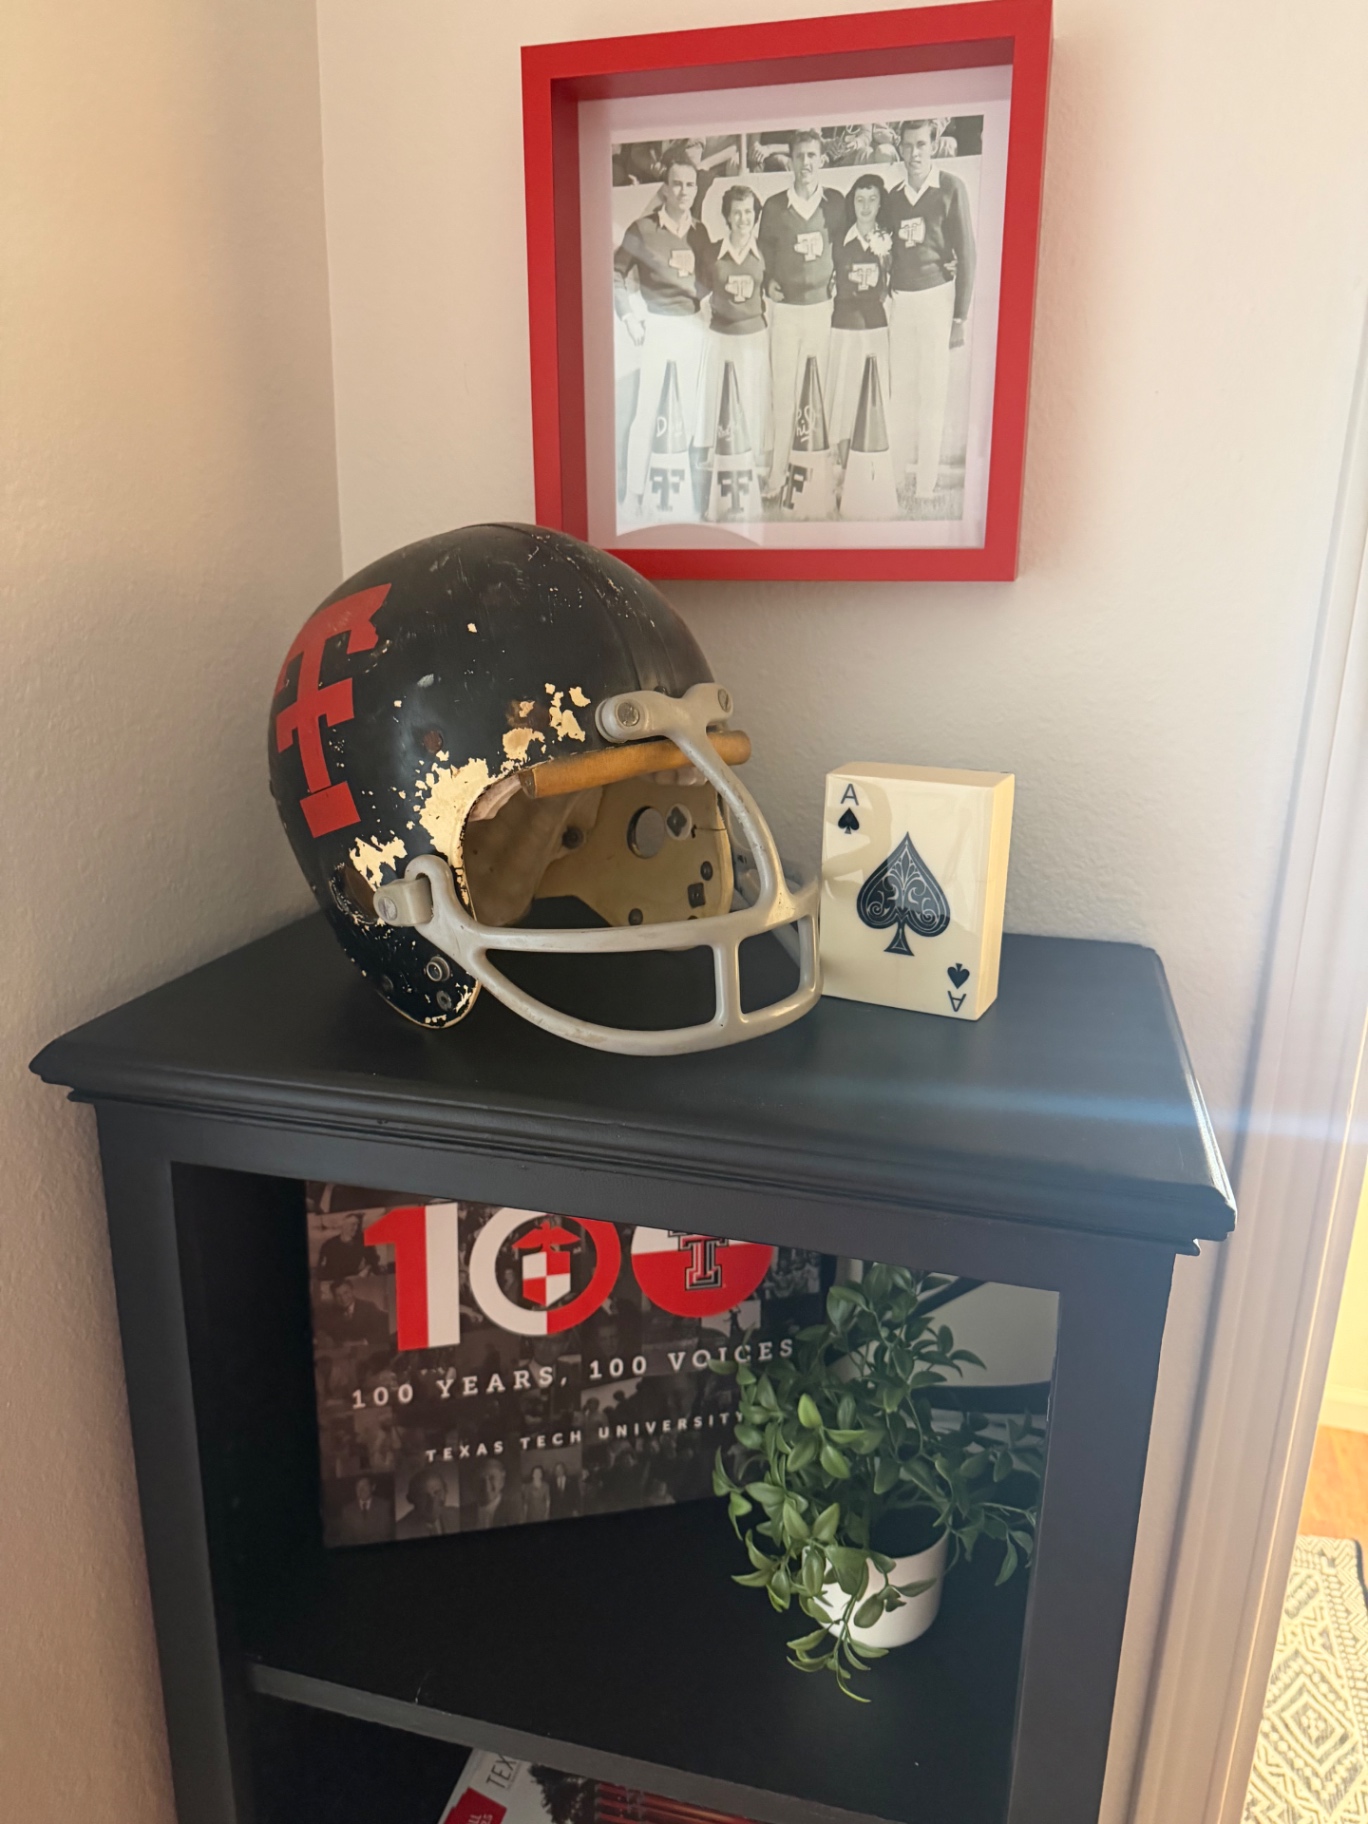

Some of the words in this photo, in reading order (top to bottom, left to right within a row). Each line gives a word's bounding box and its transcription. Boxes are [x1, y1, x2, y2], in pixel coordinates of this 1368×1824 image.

[840, 783, 859, 806] A
[947, 990, 967, 1012] A
[352, 1383, 413, 1409] 100
[436, 1366, 568, 1398] YEARS,
[589, 1355, 647, 1380] 100
[667, 1338, 794, 1372] VOICES
[426, 1440, 504, 1463] TEXAS
[520, 1429, 582, 1450] TECH
[598, 1411, 744, 1439] UNIVERSITY
